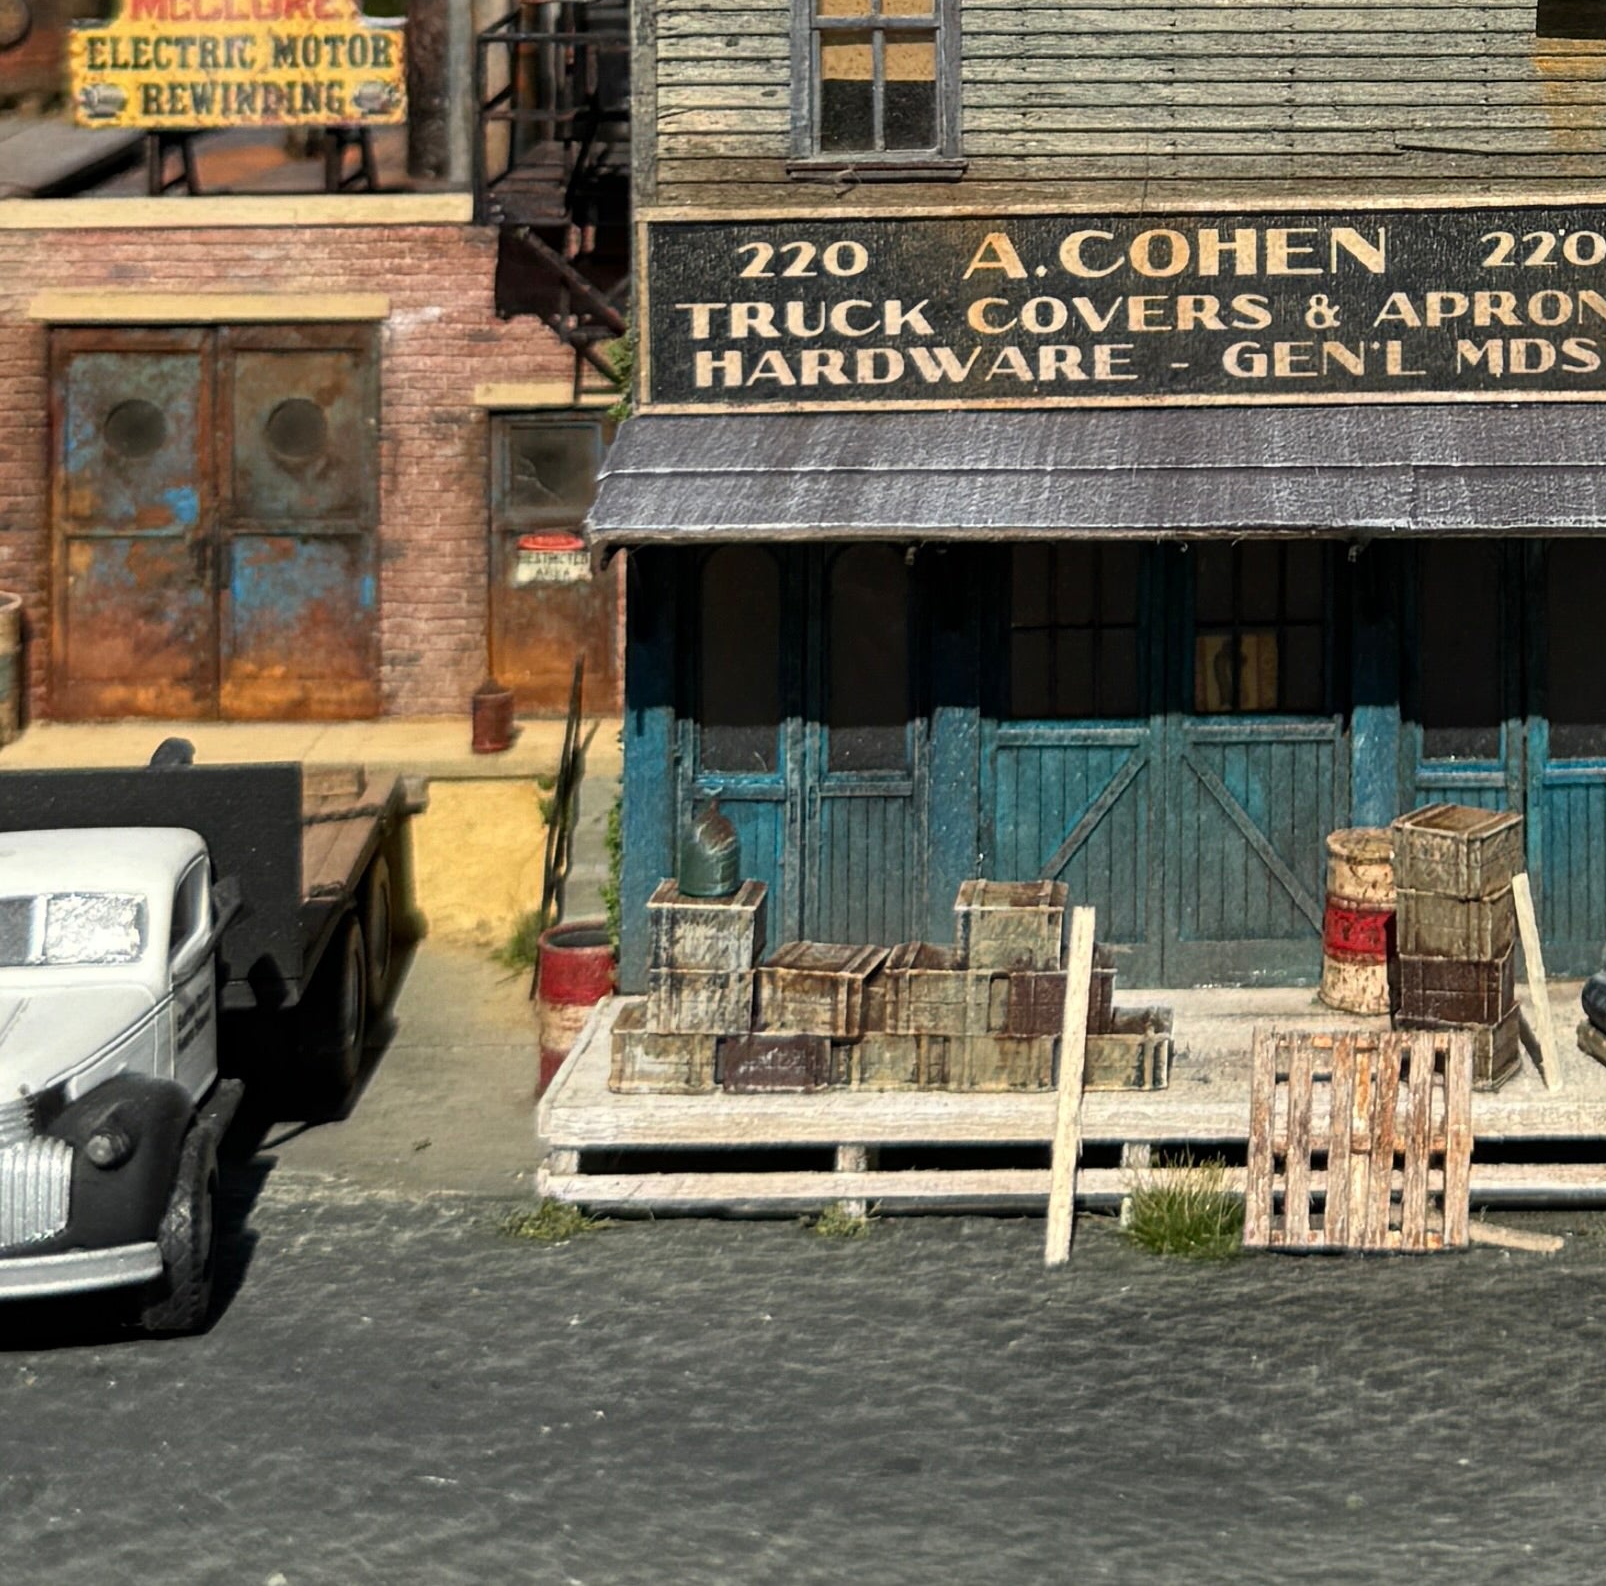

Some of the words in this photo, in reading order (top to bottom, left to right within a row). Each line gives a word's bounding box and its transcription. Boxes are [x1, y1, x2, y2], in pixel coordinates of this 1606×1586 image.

[86, 35, 257, 71] ELECTRIC
[271, 34, 393, 69] MOTOR
[138, 80, 347, 117] REWINDING
[737, 240, 869, 279] 220
[674, 298, 936, 340] TRUCK
[966, 293, 1273, 335] COVERS
[1304, 293, 1341, 330] &
[694, 343, 1140, 388] HARDWARE
[1221, 341, 1427, 379] GEN'L
